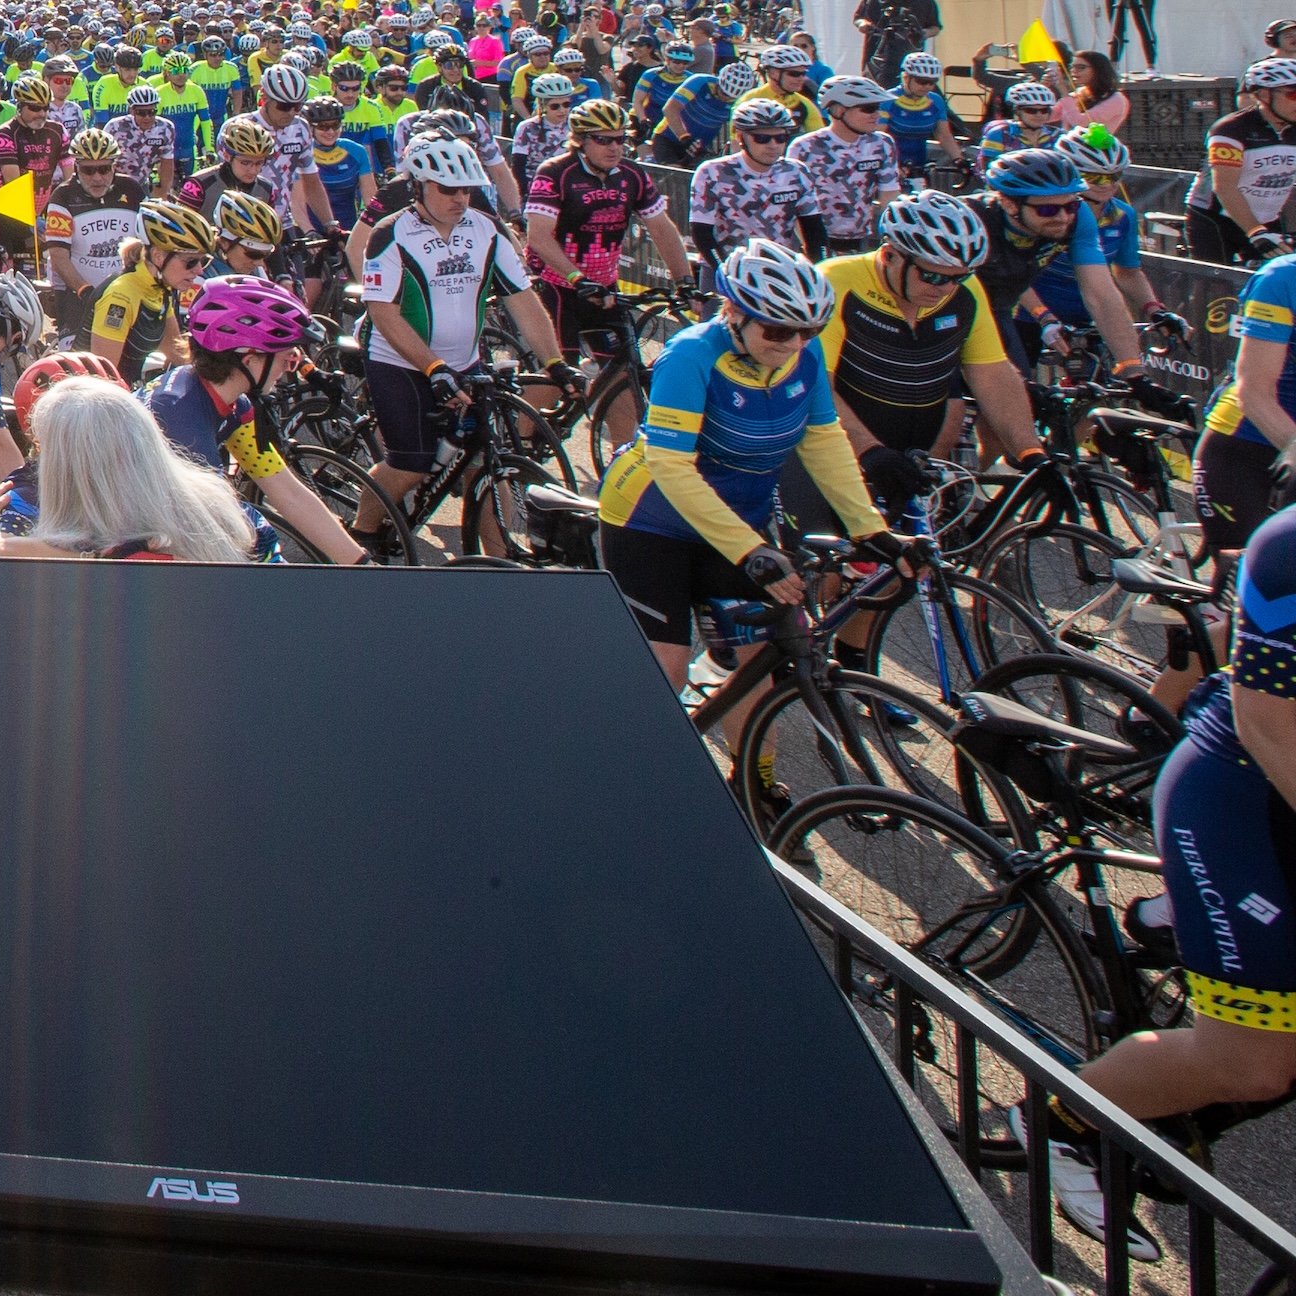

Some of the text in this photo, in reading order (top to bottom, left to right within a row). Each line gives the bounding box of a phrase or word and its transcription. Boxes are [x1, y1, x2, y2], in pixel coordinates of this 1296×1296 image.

[201, 81, 230, 91] MARANT
[162, 102, 198, 115] MARANT
[24, 145, 51, 154] STEVE'S
[283, 144, 301, 152] CAPCO
[858, 161, 880, 171] CAPCO
[183, 181, 201, 196] OX
[1238, 186, 1269, 197] CYCLE
[582, 189, 628, 204] STEVE'S
[774, 192, 798, 204] CAPCO
[81, 219, 130, 236] STEVE'S
[78, 257, 104, 269] CYCLE
[647, 265, 671, 279] KPMG
[429, 275, 481, 287] CYCLE PATHS
[446, 286, 464, 295] 2010
[855, 310, 900, 333] AMBASSADOR
[1173, 826, 1244, 974] FIERACAPITAL
[146, 1177, 241, 1204] ASUS
